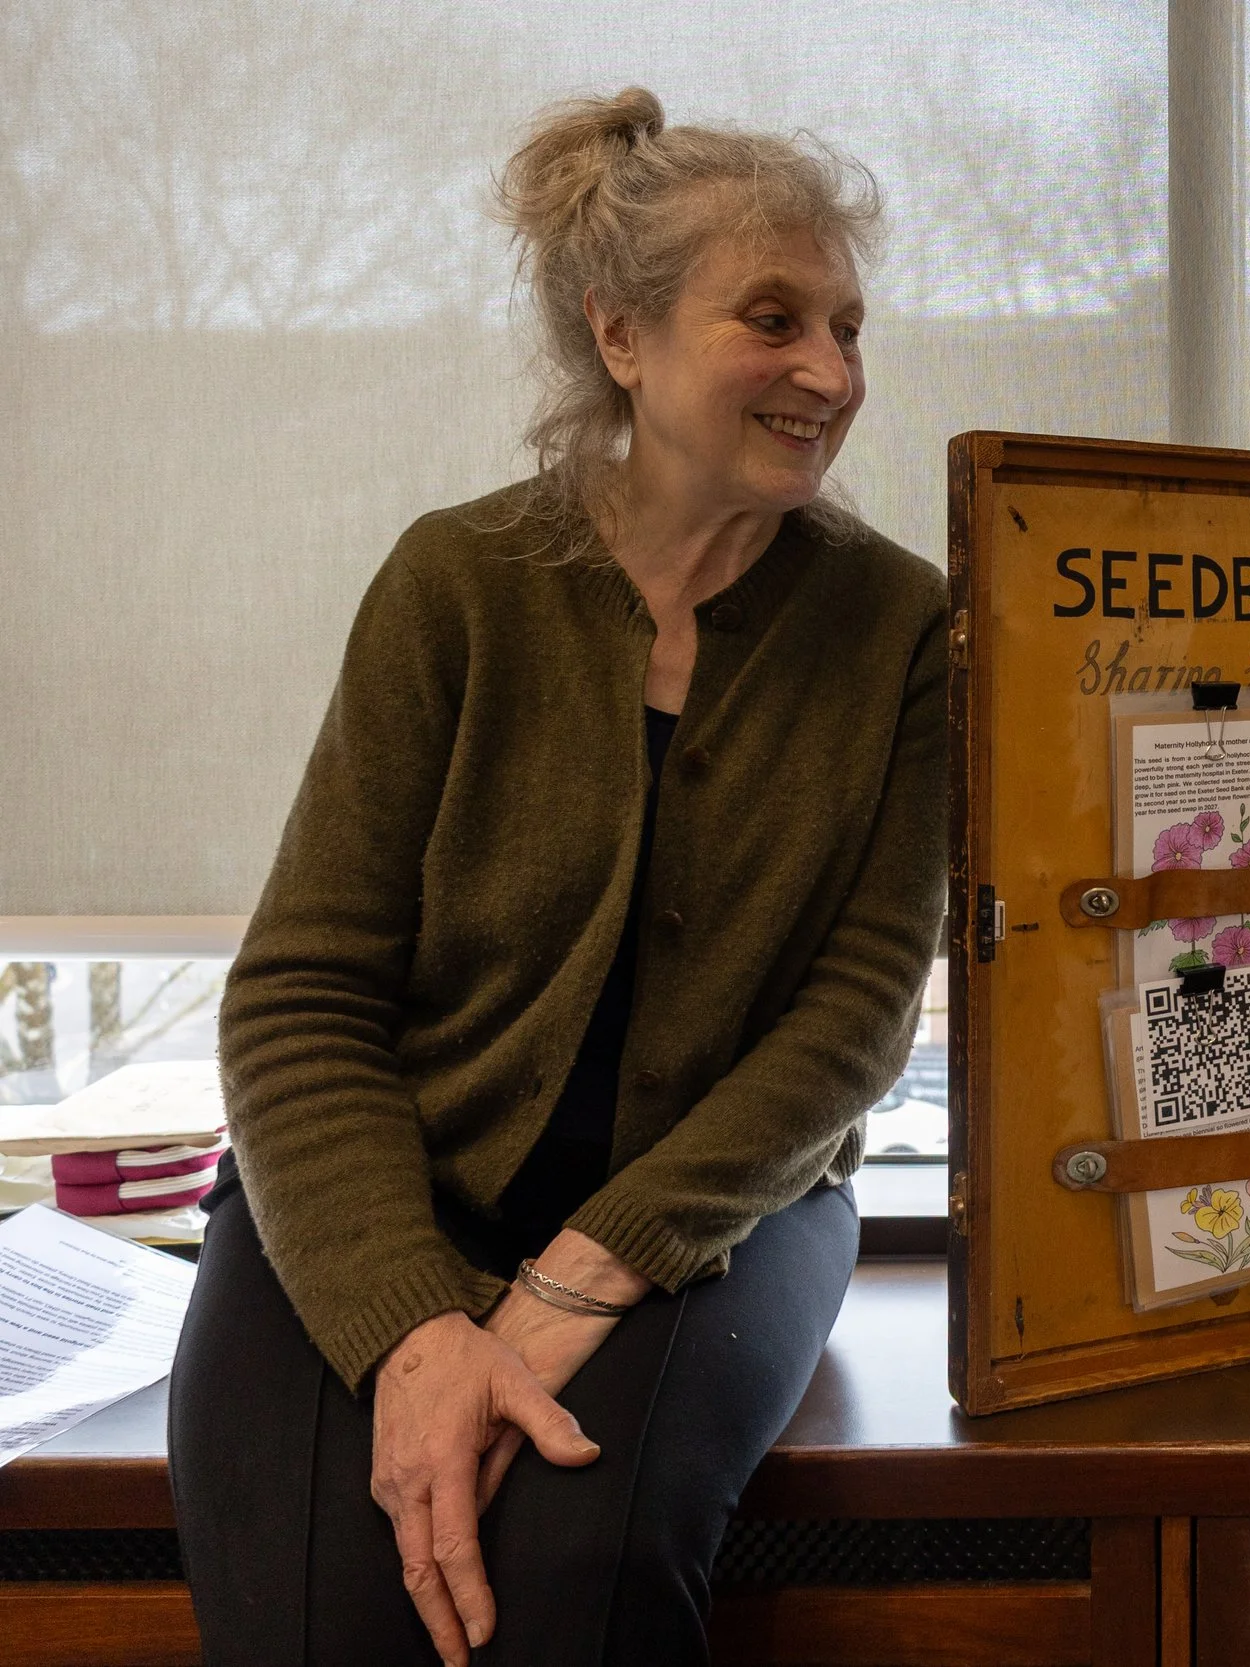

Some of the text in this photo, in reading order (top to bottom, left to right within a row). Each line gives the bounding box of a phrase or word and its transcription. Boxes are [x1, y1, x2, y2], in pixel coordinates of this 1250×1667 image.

[1185, 740, 1218, 748] Hollyhock
[1134, 766, 1164, 774] powerfully
[1193, 1127, 1215, 1136] biennial
[1224, 1119, 1248, 1129] flowered
